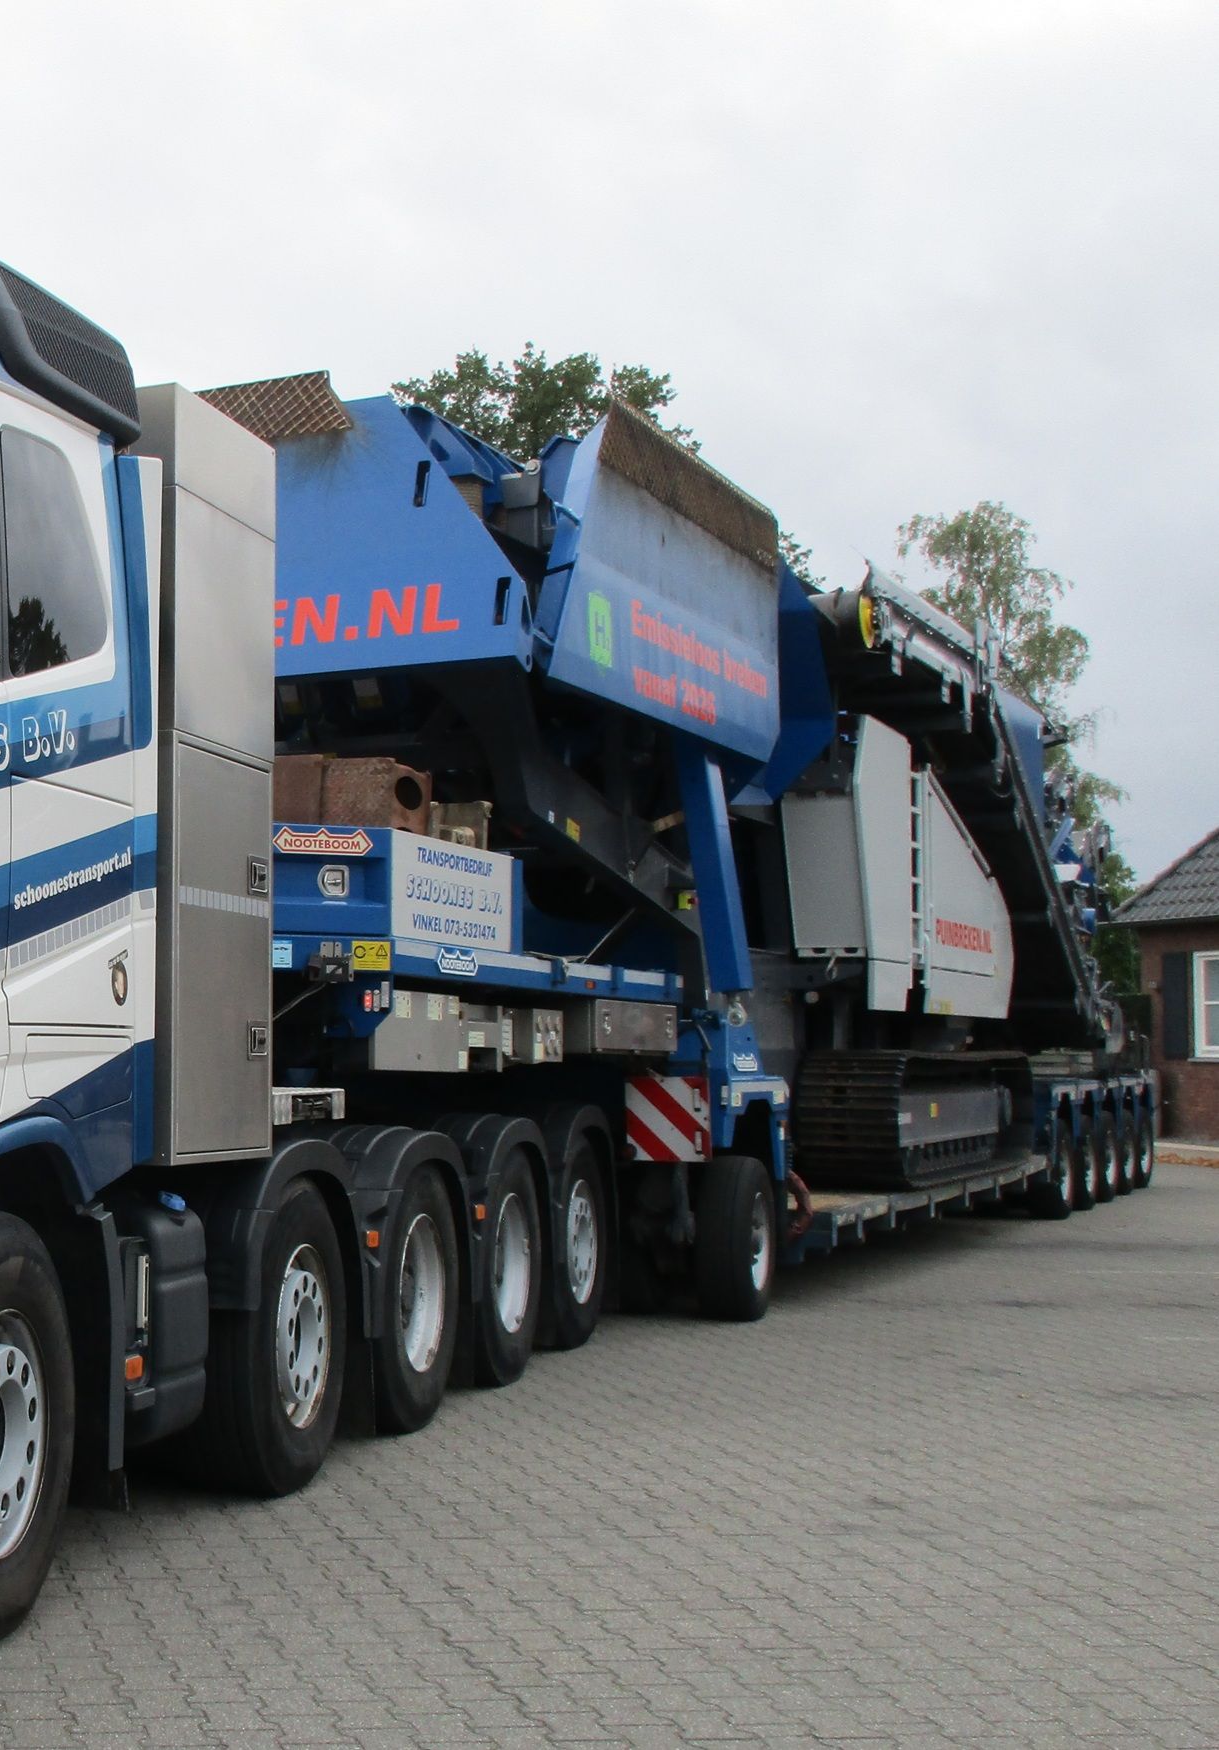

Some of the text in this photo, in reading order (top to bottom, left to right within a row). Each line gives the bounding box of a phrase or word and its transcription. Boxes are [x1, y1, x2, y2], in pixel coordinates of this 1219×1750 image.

[21, 709, 76, 763] B.V.
[283, 838, 361, 850] NOOTEBOOM
[417, 847, 493, 877] TRANSPORTBEDRIJF
[13, 846, 132, 910] schoonestransport.nl
[406, 873, 503, 915] SCHOONES B.V.
[412, 913, 497, 941] VINKEL 073-5321474
[935, 918, 993, 954] PUINBREKEN.NL
